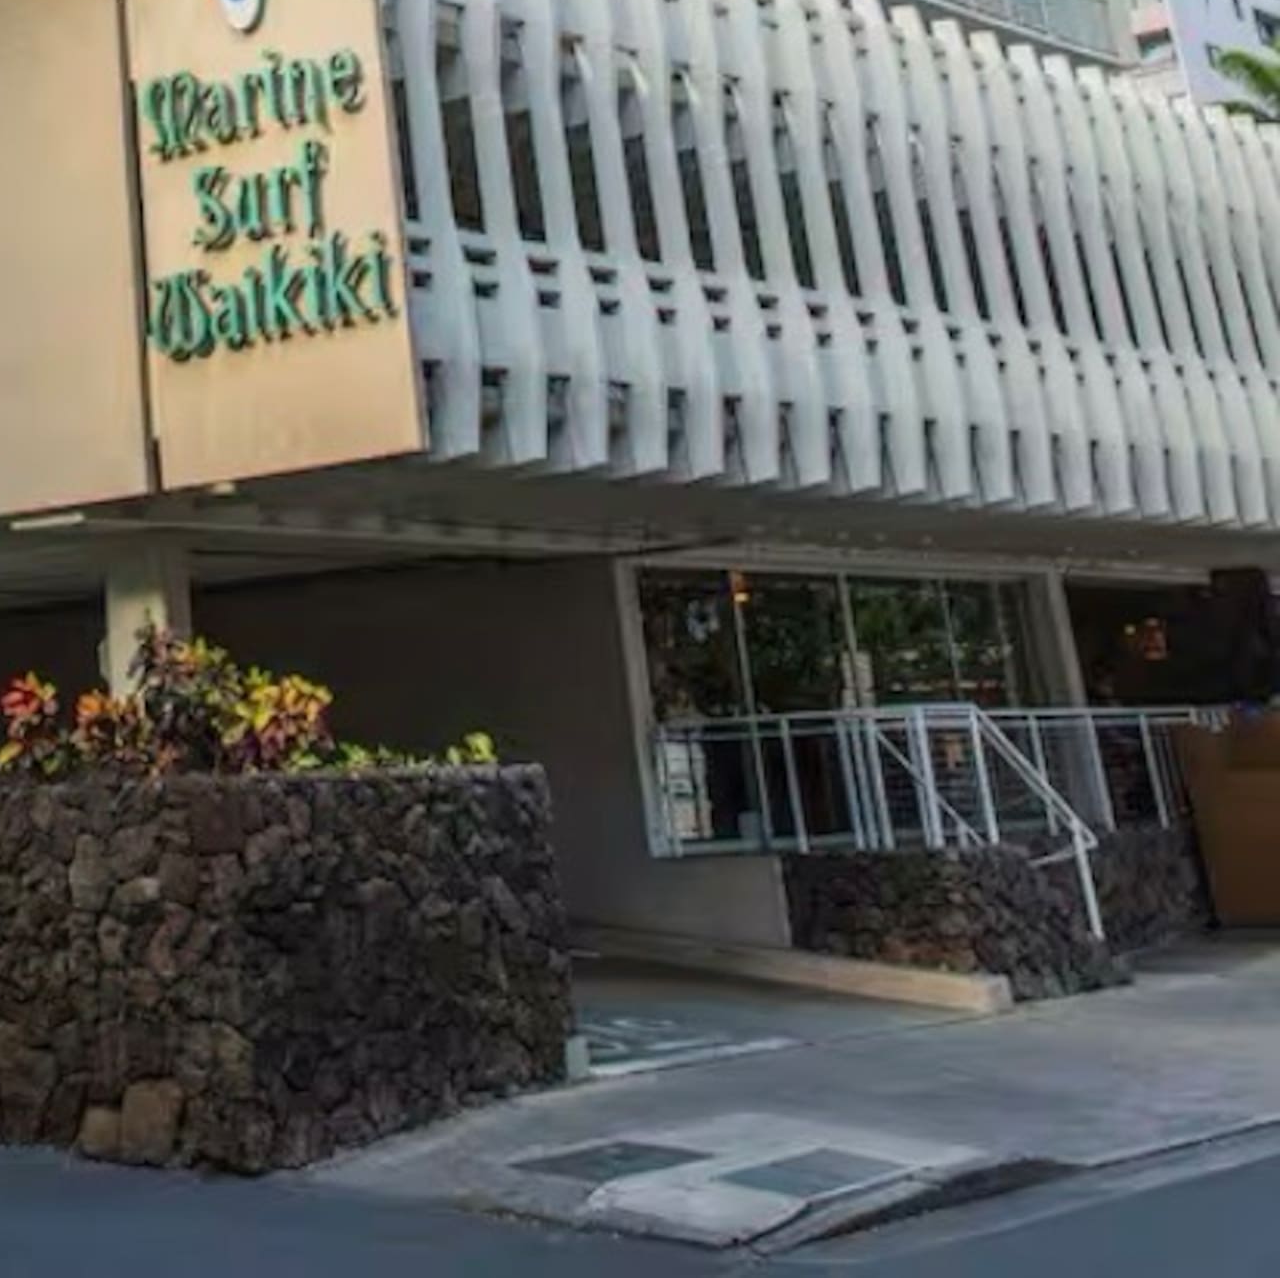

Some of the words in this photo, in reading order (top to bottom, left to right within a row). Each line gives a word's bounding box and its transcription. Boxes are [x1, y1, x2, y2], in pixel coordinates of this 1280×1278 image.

[144, 49, 365, 163] Marine
[192, 139, 328, 251] Surf
[147, 232, 398, 362] Waikiki
